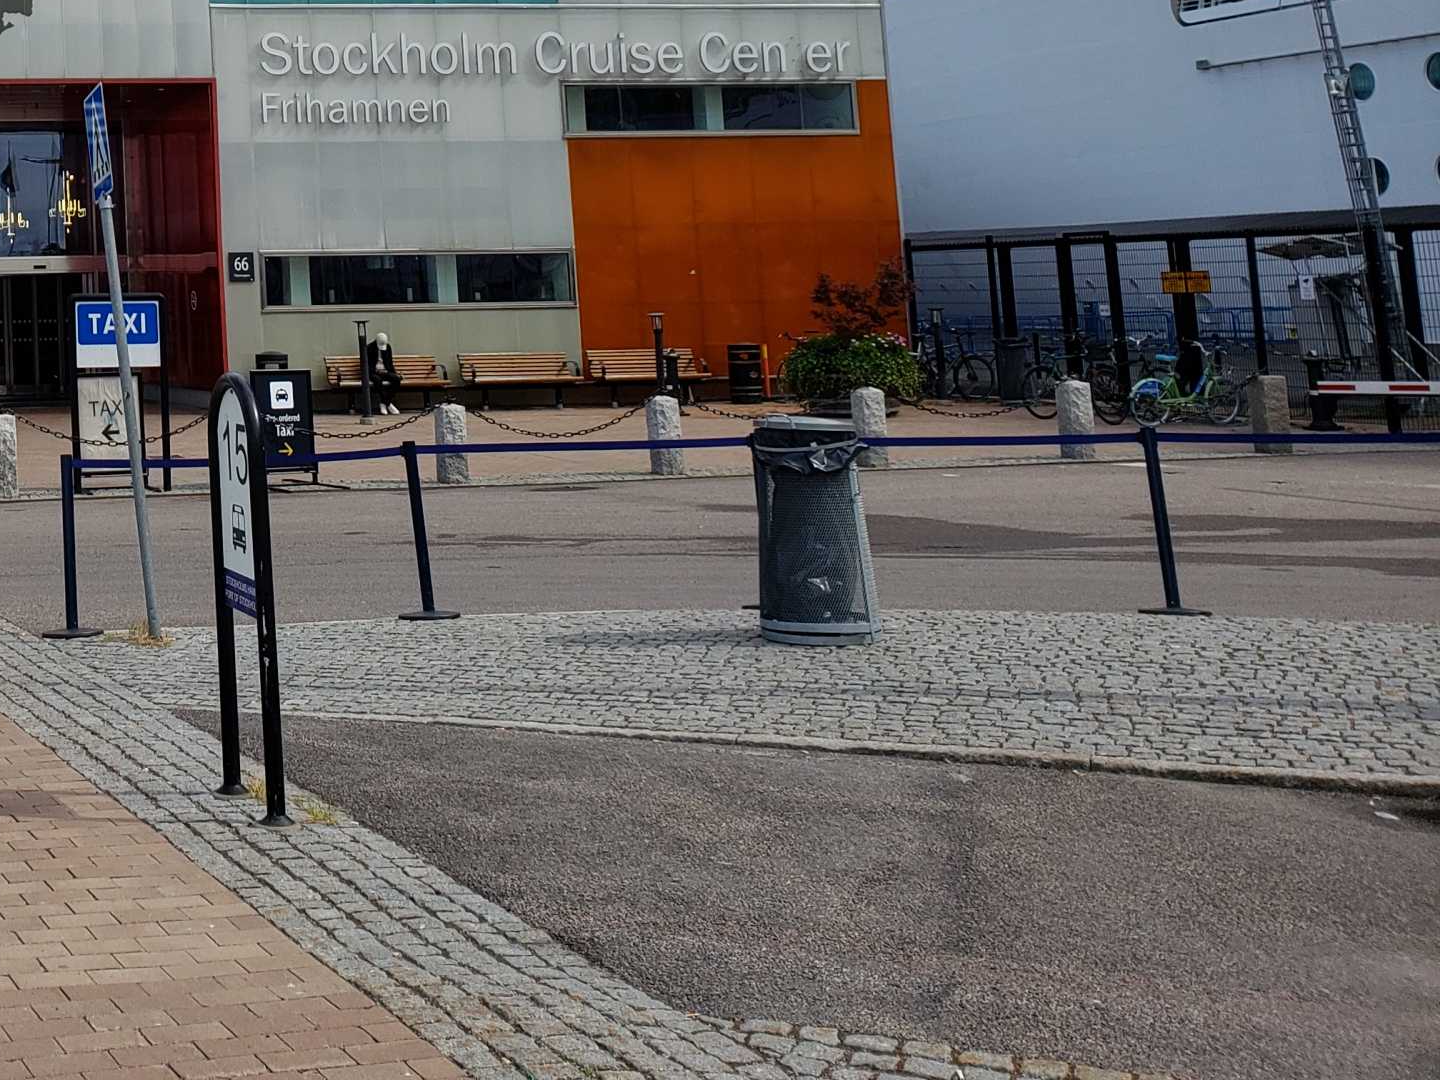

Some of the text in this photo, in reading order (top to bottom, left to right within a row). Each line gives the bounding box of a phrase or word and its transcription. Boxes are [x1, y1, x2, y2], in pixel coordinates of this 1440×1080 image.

[260, 31, 851, 76] Stockholm Cruise Cener
[262, 92, 451, 124] Frihamnen
[234, 256, 249, 271] 66
[88, 312, 146, 335] TAXI
[88, 399, 124, 417] TAX
[264, 413, 300, 422] P-ordered
[275, 423, 295, 437] Taxi
[223, 420, 248, 486] 15
